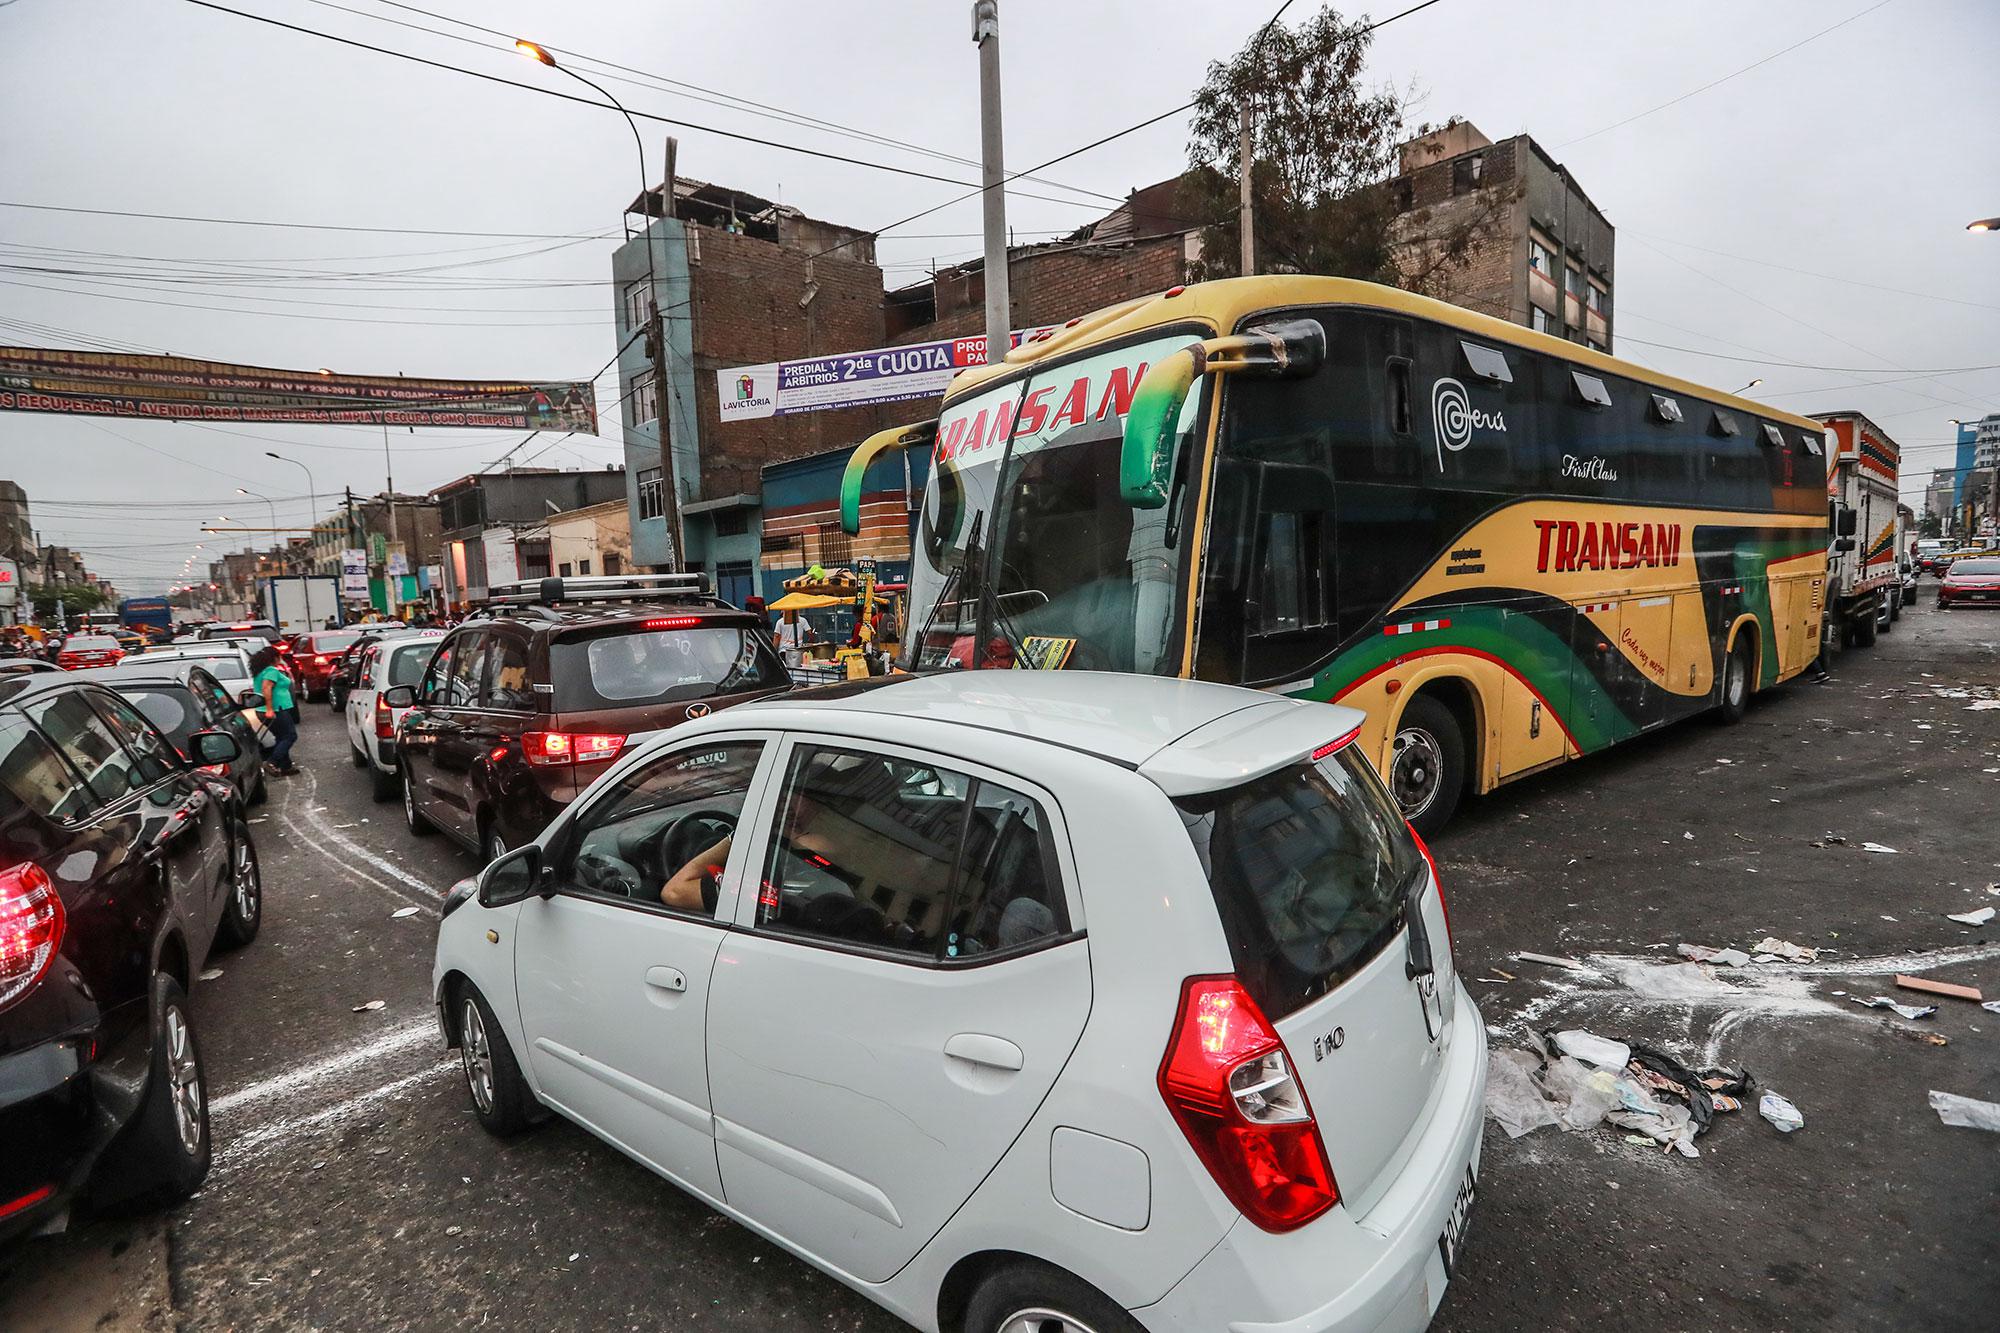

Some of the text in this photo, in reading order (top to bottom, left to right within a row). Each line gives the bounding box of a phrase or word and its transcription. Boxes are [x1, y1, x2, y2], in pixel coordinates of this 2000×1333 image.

[957, 340, 988, 353] PRO
[784, 361, 838, 378] PREDIAL Y
[843, 347, 950, 380] 2da CUOTA
[139, 373, 206, 385] MUNICIPAL
[785, 371, 839, 387] ARBITRIOS
[16, 393, 114, 413] RECUPERAR
[139, 402, 203, 418] AVENIDA
[204, 404, 242, 419] PARA
[330, 410, 373, 423] LIMPIA
[373, 410, 383, 422] Y
[385, 411, 431, 424] SEGURA
[432, 412, 466, 425] COMO
[466, 414, 513, 426] SIEMPRE
[1562, 454, 1618, 481] First Class
[1533, 519, 1682, 573] TRANSANI
[1314, 1025, 1345, 1063] i10
